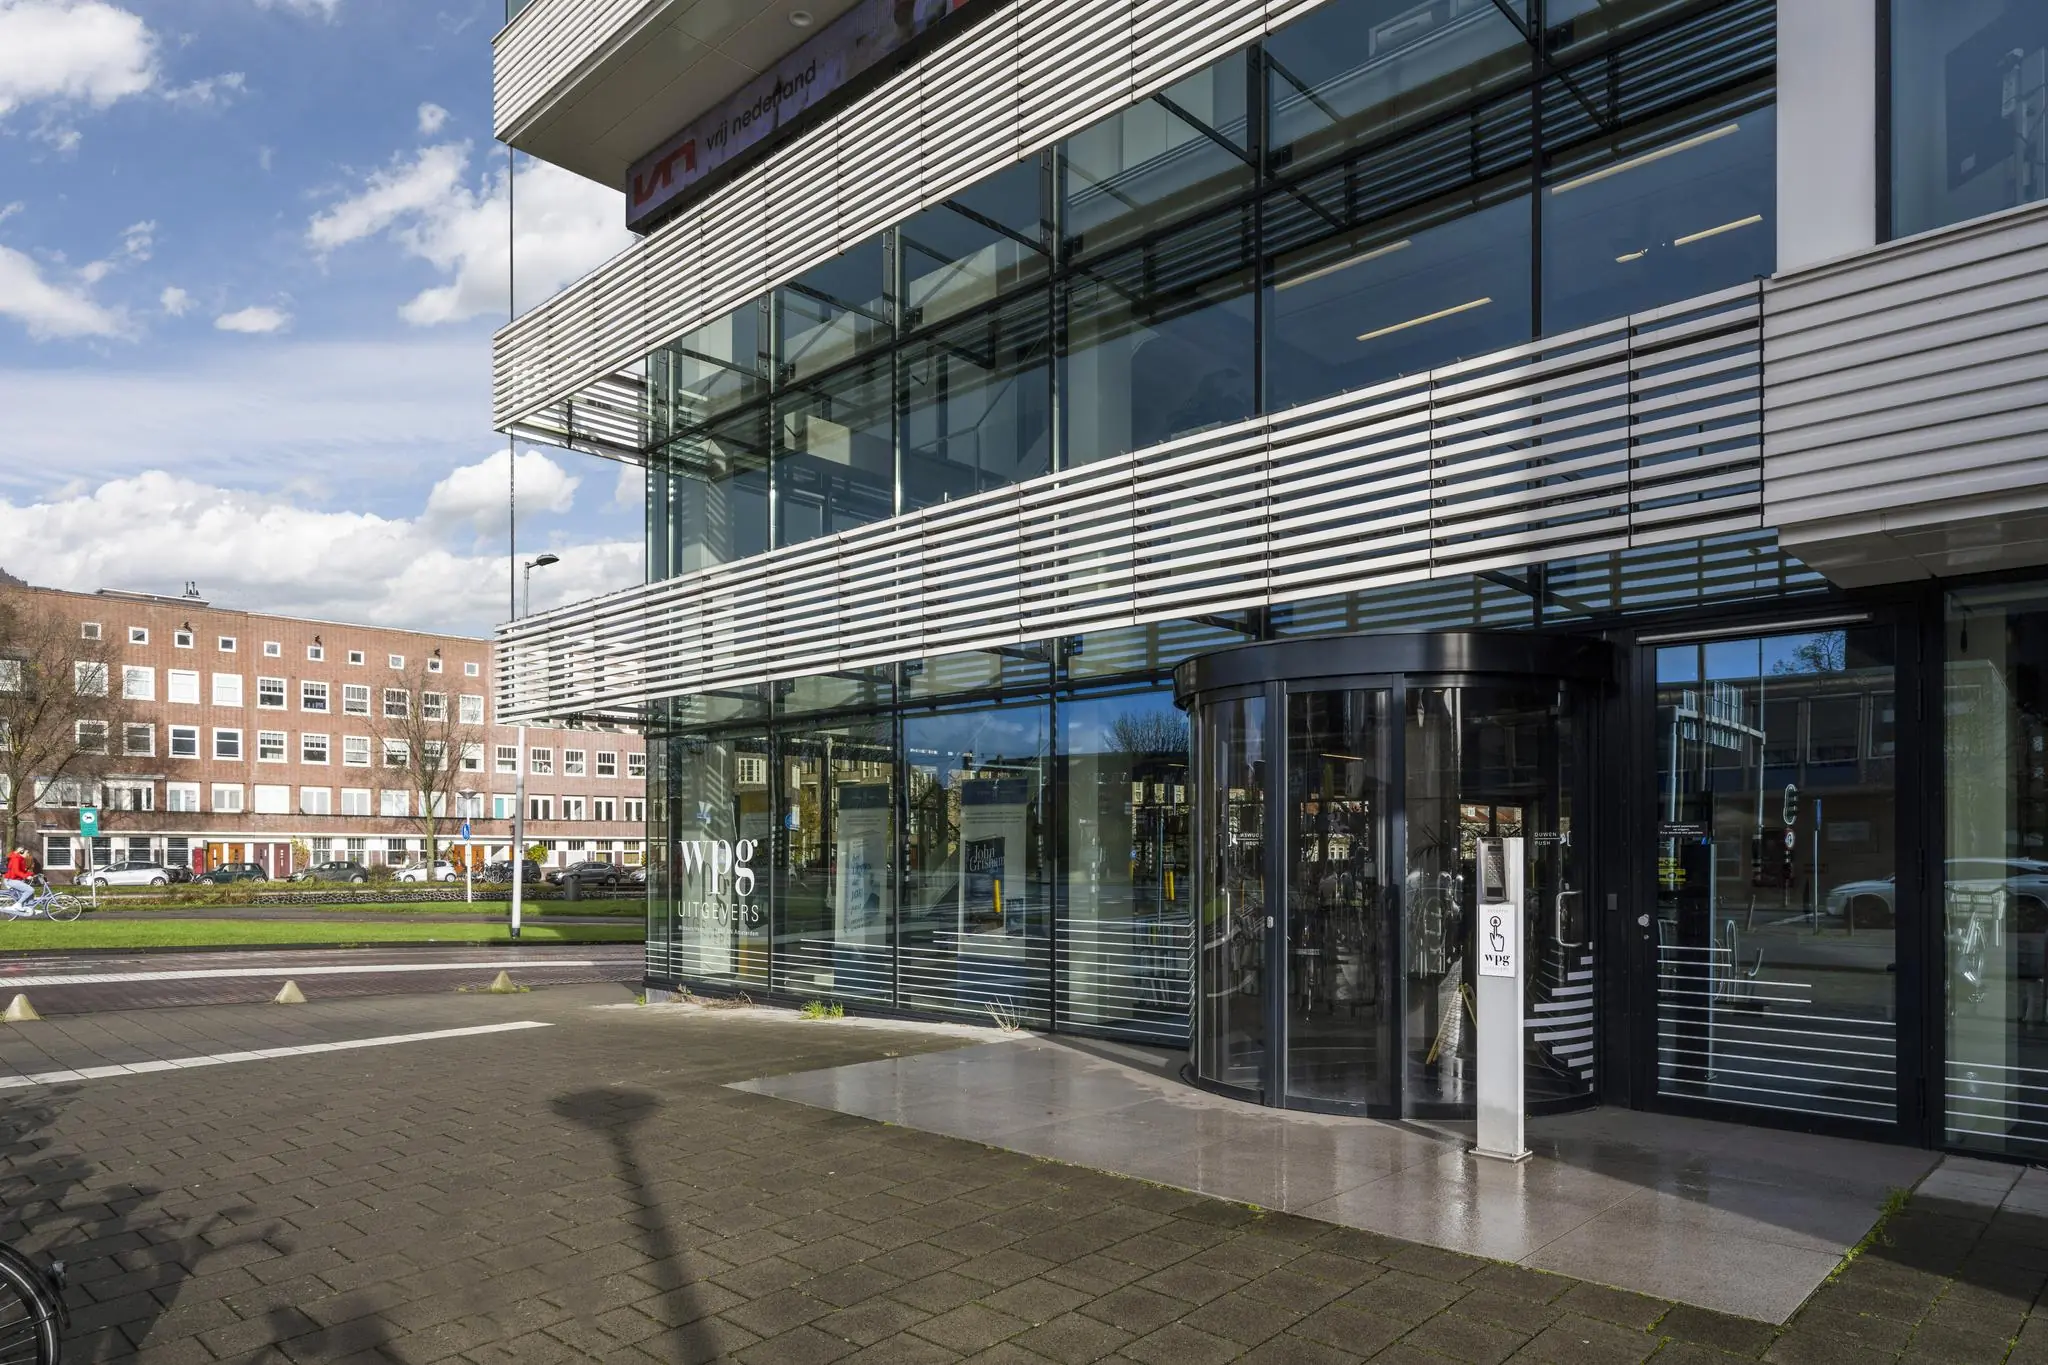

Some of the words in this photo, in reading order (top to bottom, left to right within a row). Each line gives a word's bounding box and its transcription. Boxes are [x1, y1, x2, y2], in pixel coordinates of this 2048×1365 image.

[705, 119, 728, 151] vrij
[733, 59, 816, 135] nederland
[974, 844, 995, 861] John
[678, 839, 758, 897] wpg
[970, 856, 1005, 871] Grisham
[677, 901, 759, 922] UITGEVERS
[1484, 953, 1511, 966] wpg
